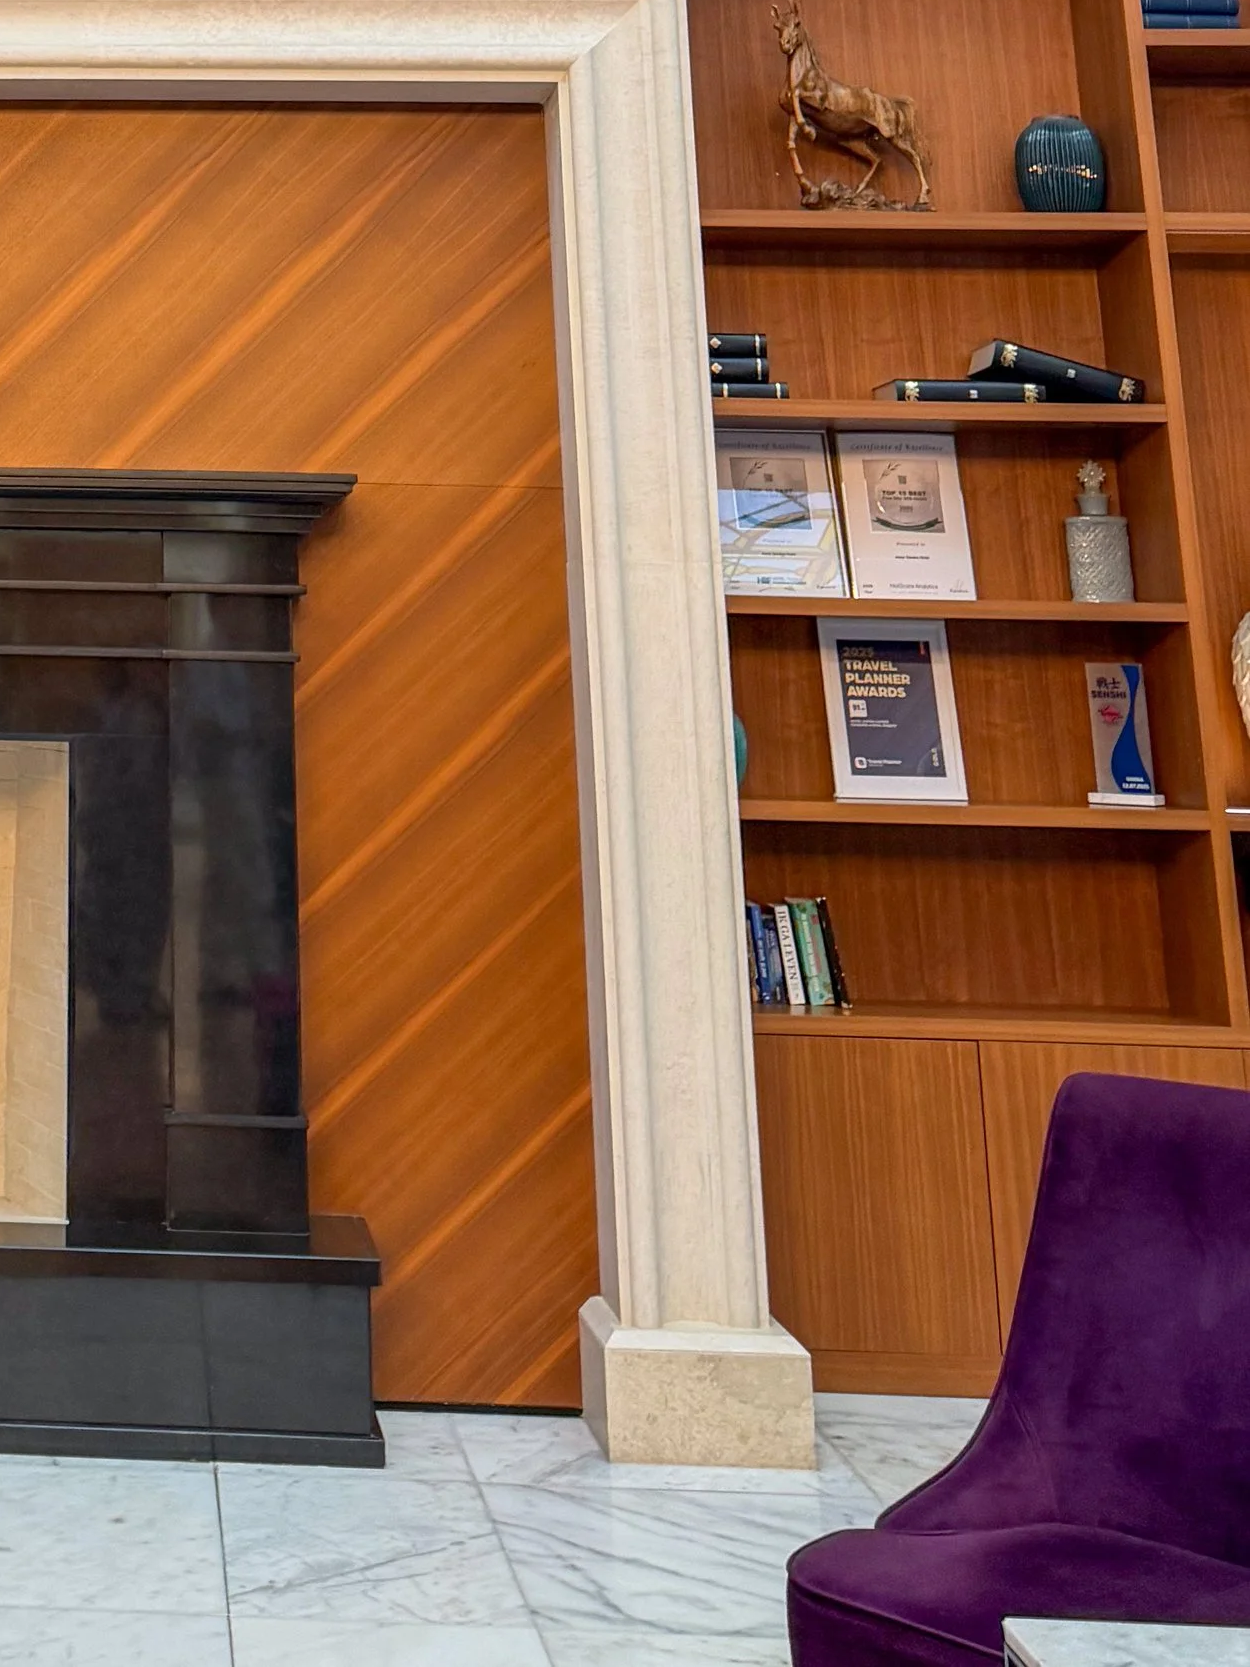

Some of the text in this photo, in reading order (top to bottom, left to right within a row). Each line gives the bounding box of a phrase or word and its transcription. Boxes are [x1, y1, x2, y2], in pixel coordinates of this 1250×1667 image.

[843, 660, 898, 671] TRAVEL
[845, 672, 911, 684] PLANNER
[847, 685, 907, 698] AWARDS
[1091, 690, 1127, 699] SENSHI
[776, 911, 788, 923] IK
[783, 943, 799, 981] LEVEN
